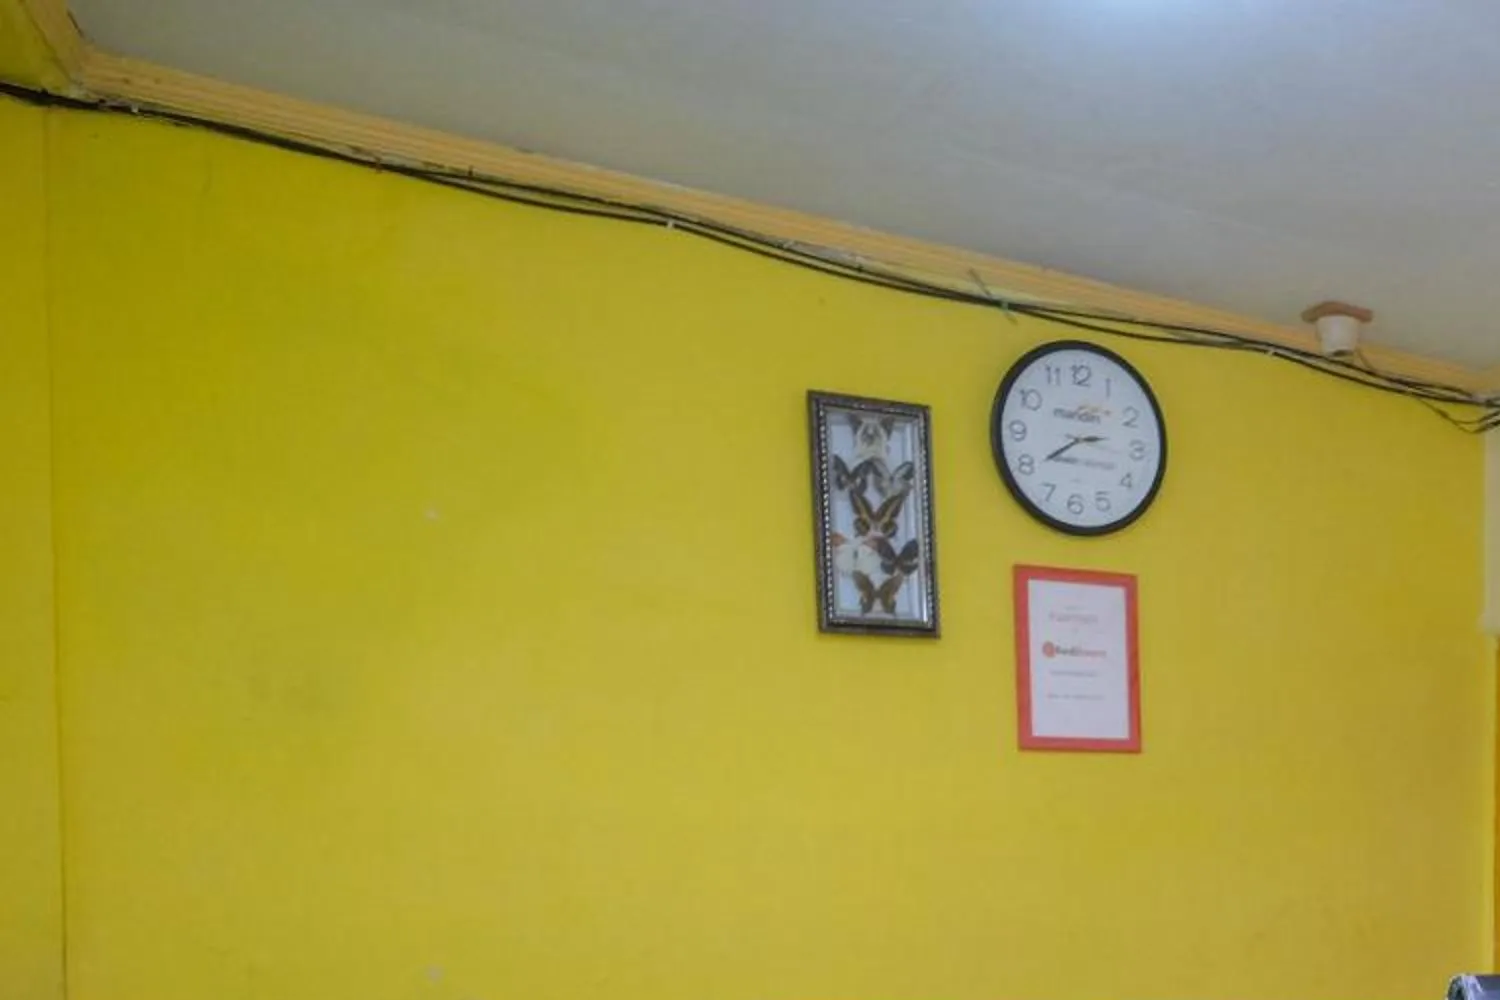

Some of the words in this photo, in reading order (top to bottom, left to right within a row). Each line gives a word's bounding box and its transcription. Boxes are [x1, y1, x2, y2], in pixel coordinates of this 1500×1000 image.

[1045, 366, 1061, 386] 11
[1071, 364, 1092, 387] 12
[1019, 388, 1043, 411] 10
[1122, 406, 1139, 428] 2
[1008, 420, 1027, 441] 9
[1129, 440, 1146, 461] 3
[1018, 454, 1035, 476] 8
[1120, 472, 1132, 489] 4
[1041, 483, 1057, 502] 7
[1095, 490, 1112, 512] 5
[1066, 494, 1085, 515] 6
